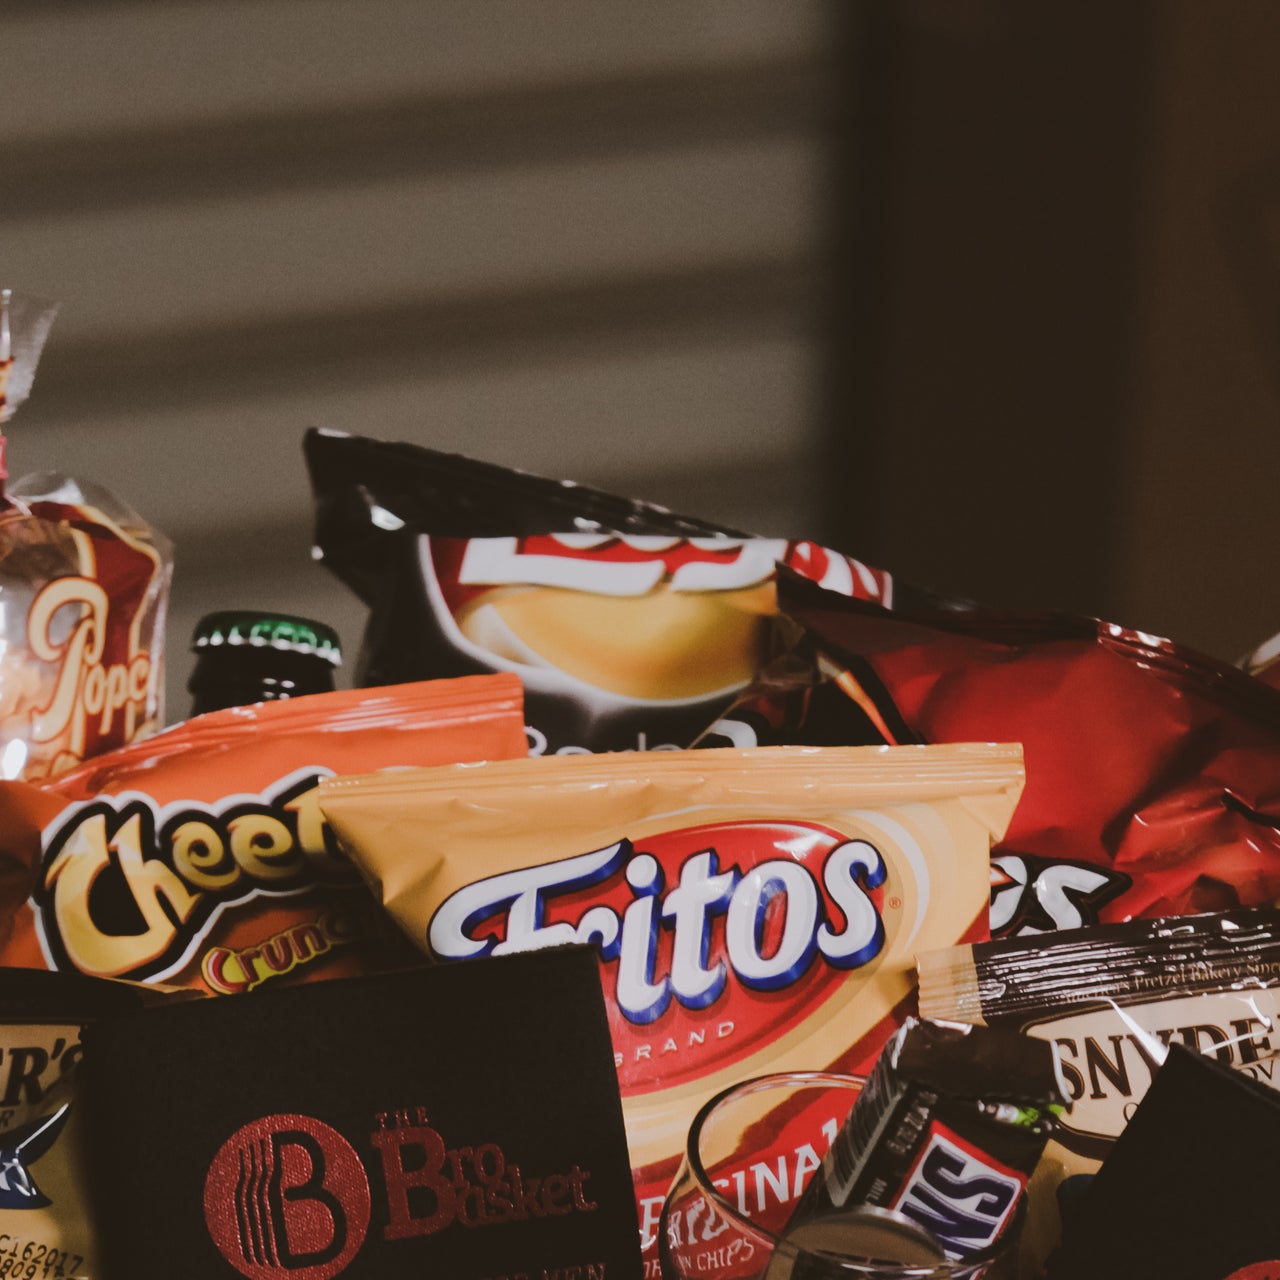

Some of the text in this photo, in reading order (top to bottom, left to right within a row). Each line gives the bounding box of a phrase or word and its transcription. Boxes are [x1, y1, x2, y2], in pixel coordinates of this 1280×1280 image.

[427, 838, 888, 1024] Fritos
[375, 1106, 428, 1131] THE
[697, 1238, 755, 1271] CHIPS
